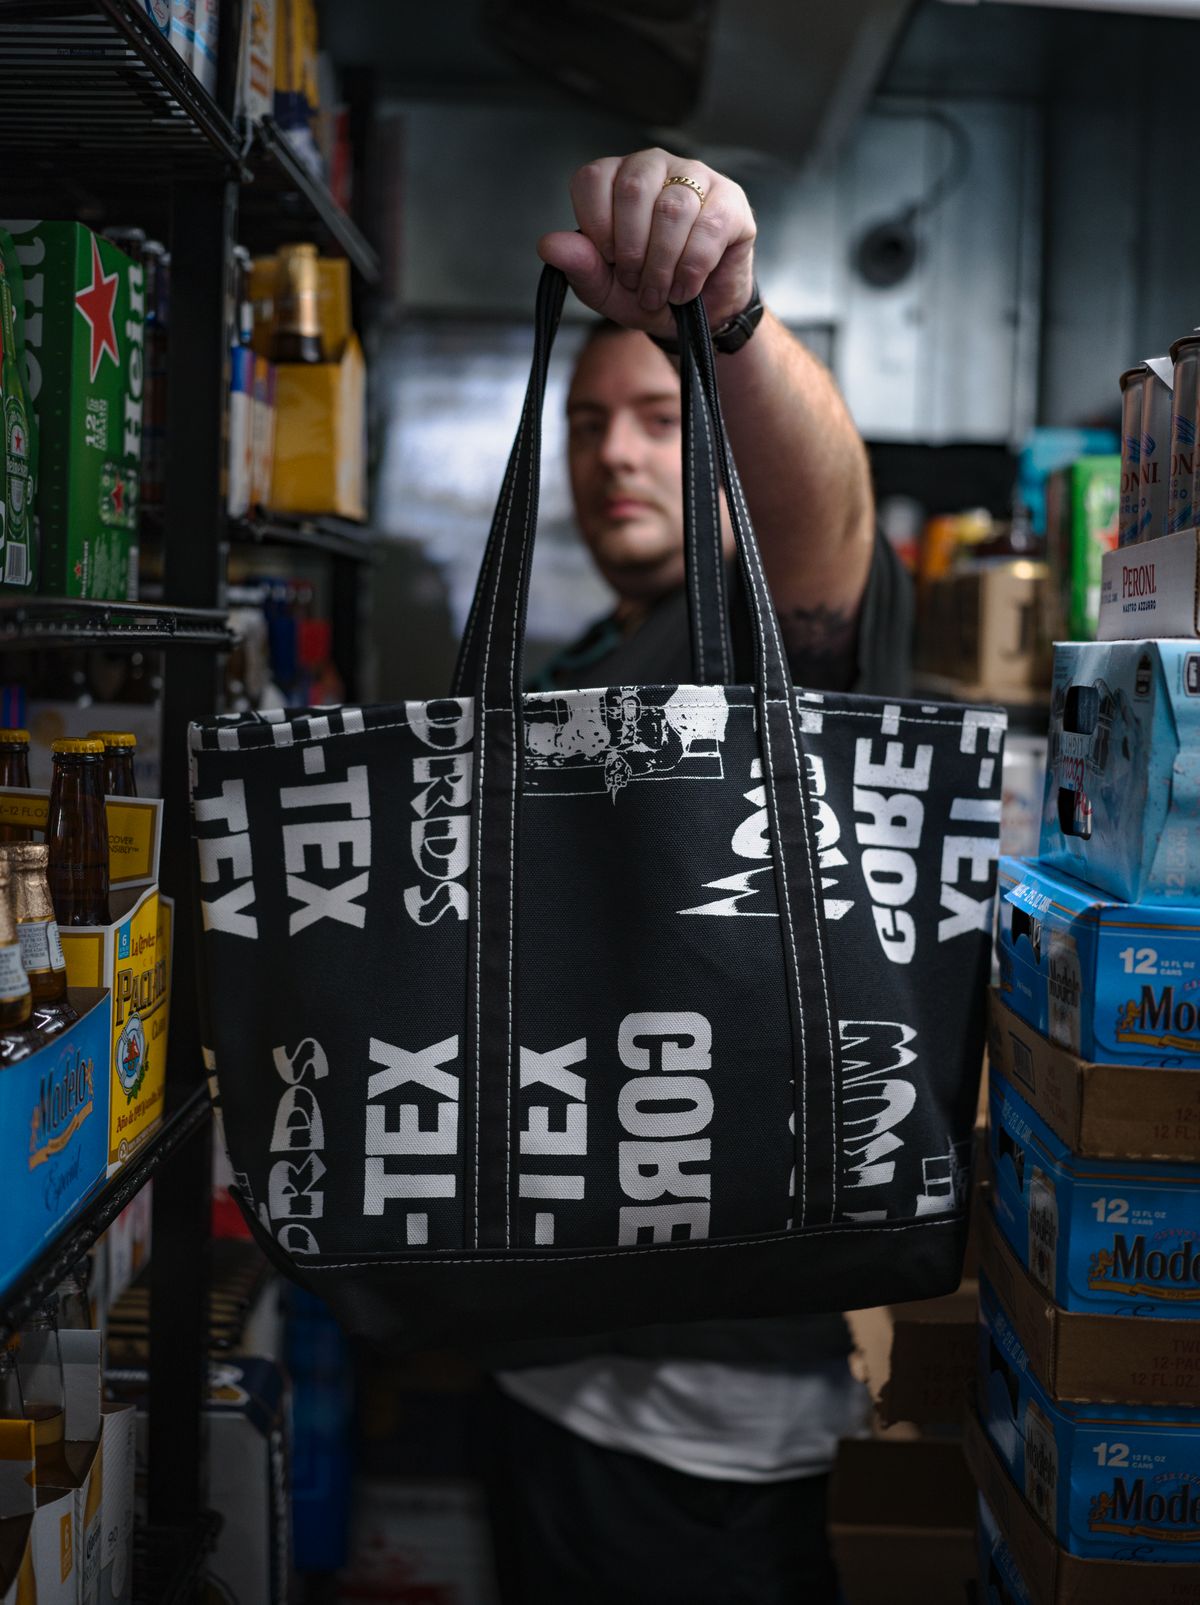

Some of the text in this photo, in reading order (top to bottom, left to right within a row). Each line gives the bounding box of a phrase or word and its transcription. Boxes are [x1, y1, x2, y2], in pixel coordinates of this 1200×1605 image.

[1119, 947, 1158, 975] 12
[1140, 983, 1200, 1033] Mo
[39, 1047, 87, 1140] Modelo
[363, 1034, 460, 1245] -TEX
[1091, 1197, 1130, 1225] 12
[1092, 1441, 1131, 1469] 12
